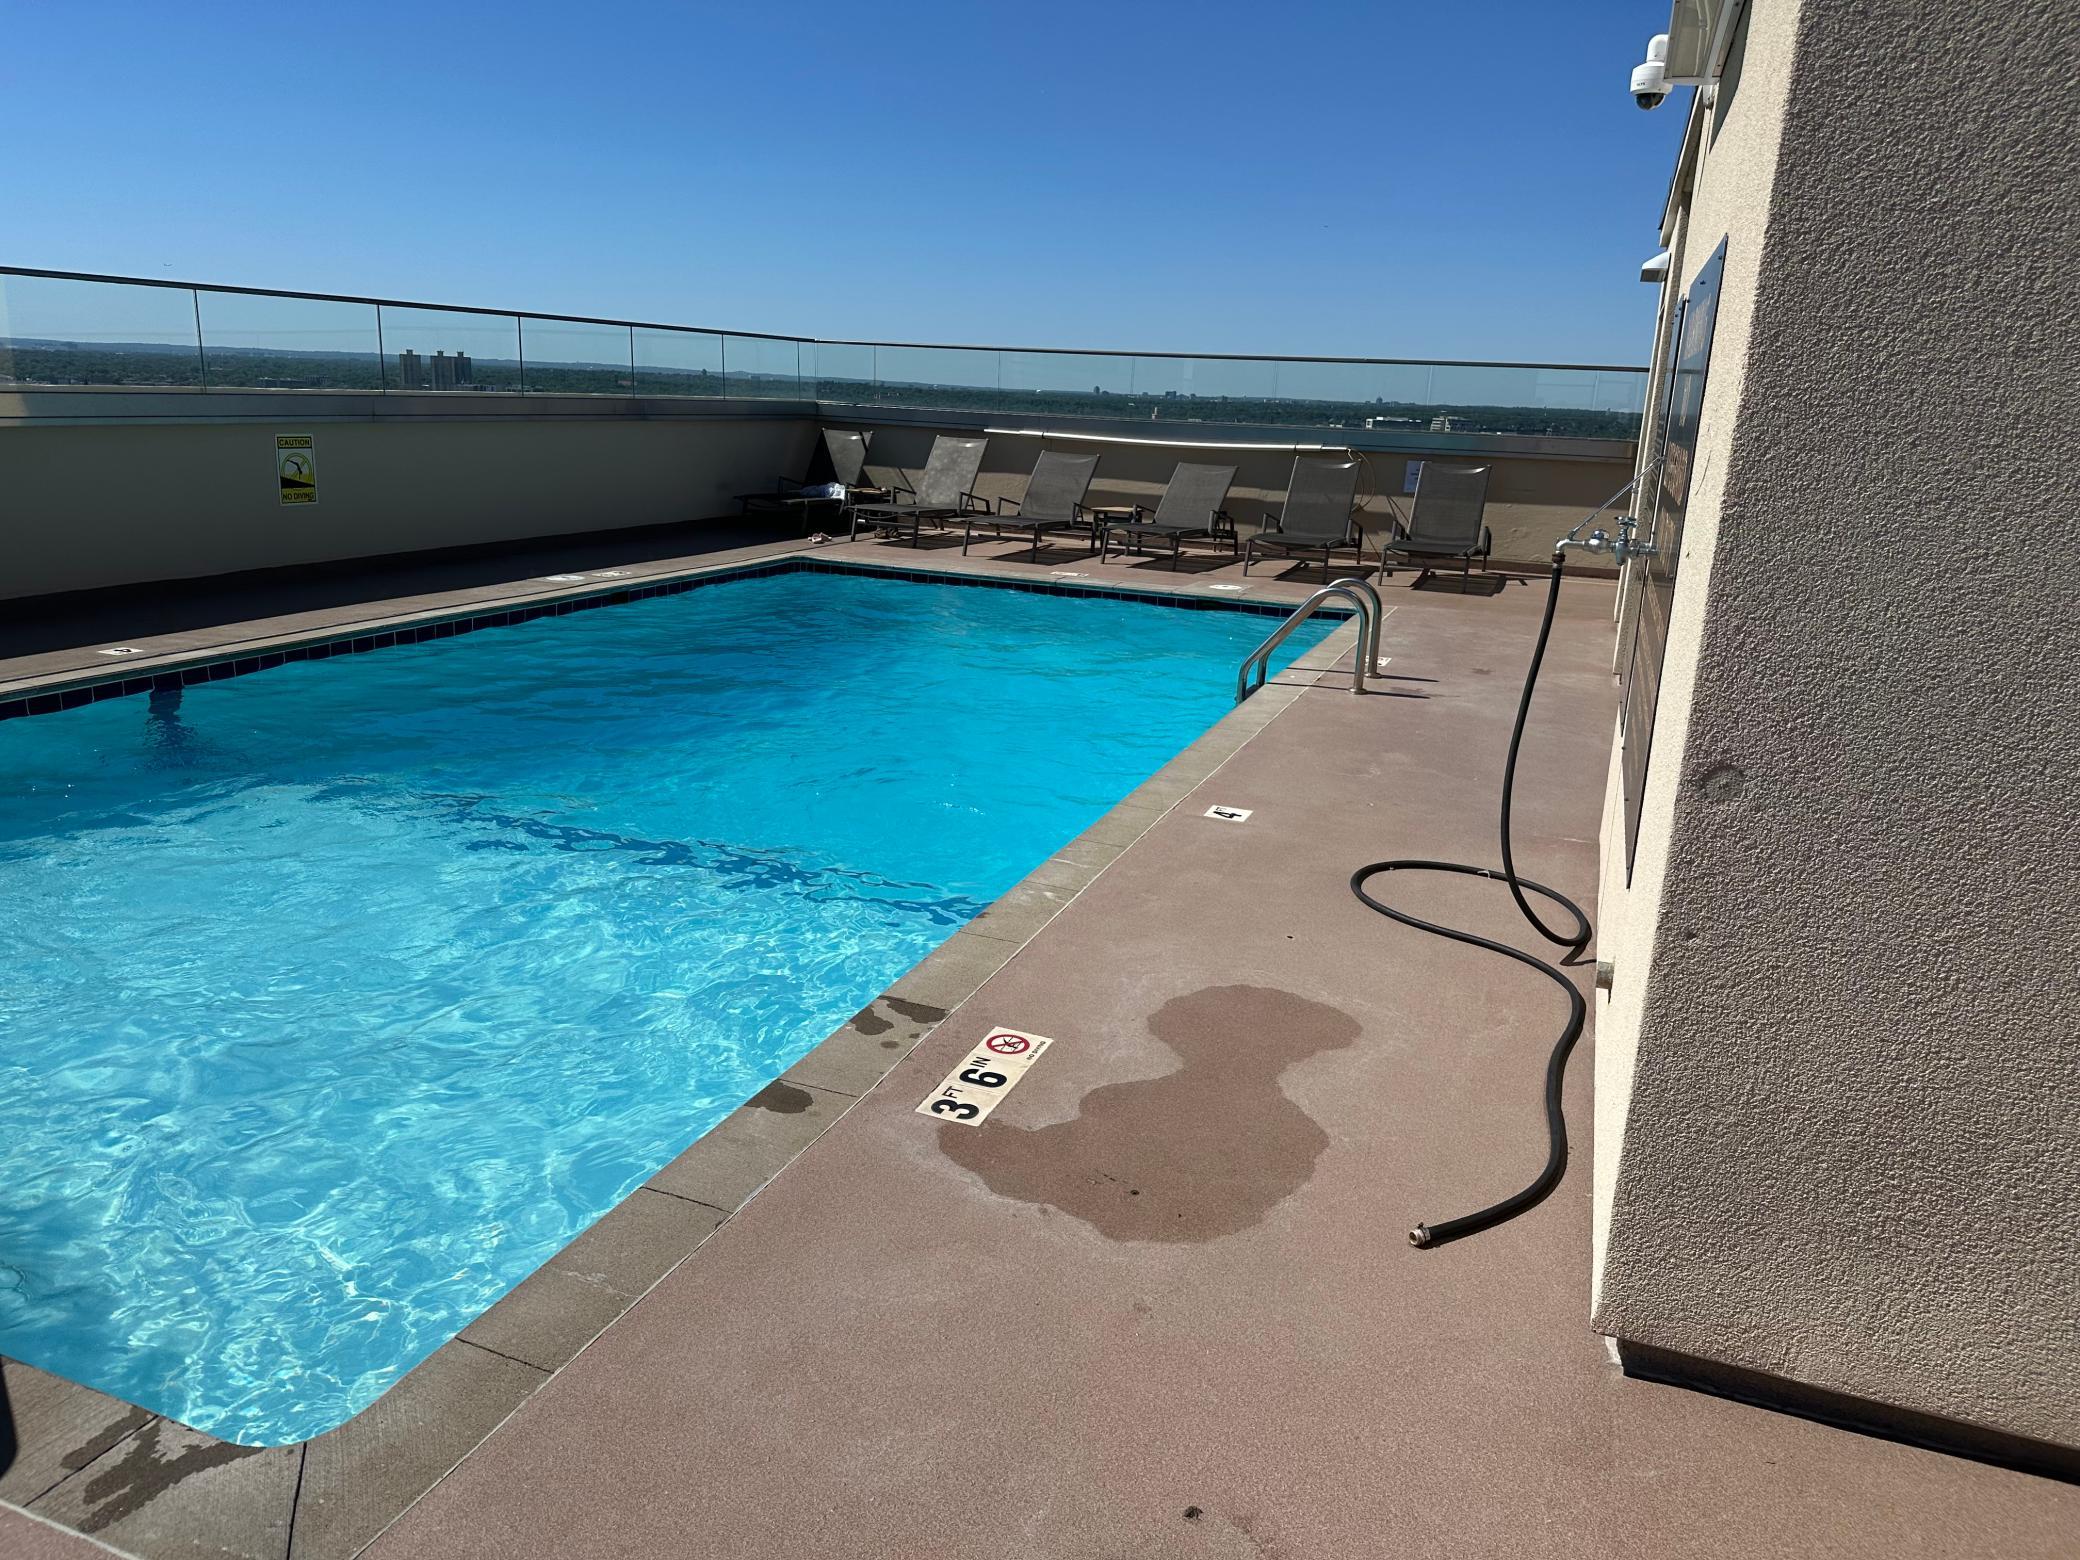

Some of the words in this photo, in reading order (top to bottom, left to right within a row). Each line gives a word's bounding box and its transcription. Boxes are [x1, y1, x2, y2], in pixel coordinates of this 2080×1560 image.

[293, 492, 315, 500] DIVING
[1213, 810, 1242, 819] 4
[970, 1056, 991, 1068] IN
[959, 1068, 1007, 1088] 6
[941, 1085, 963, 1099] FT
[931, 1099, 980, 1120] 3
